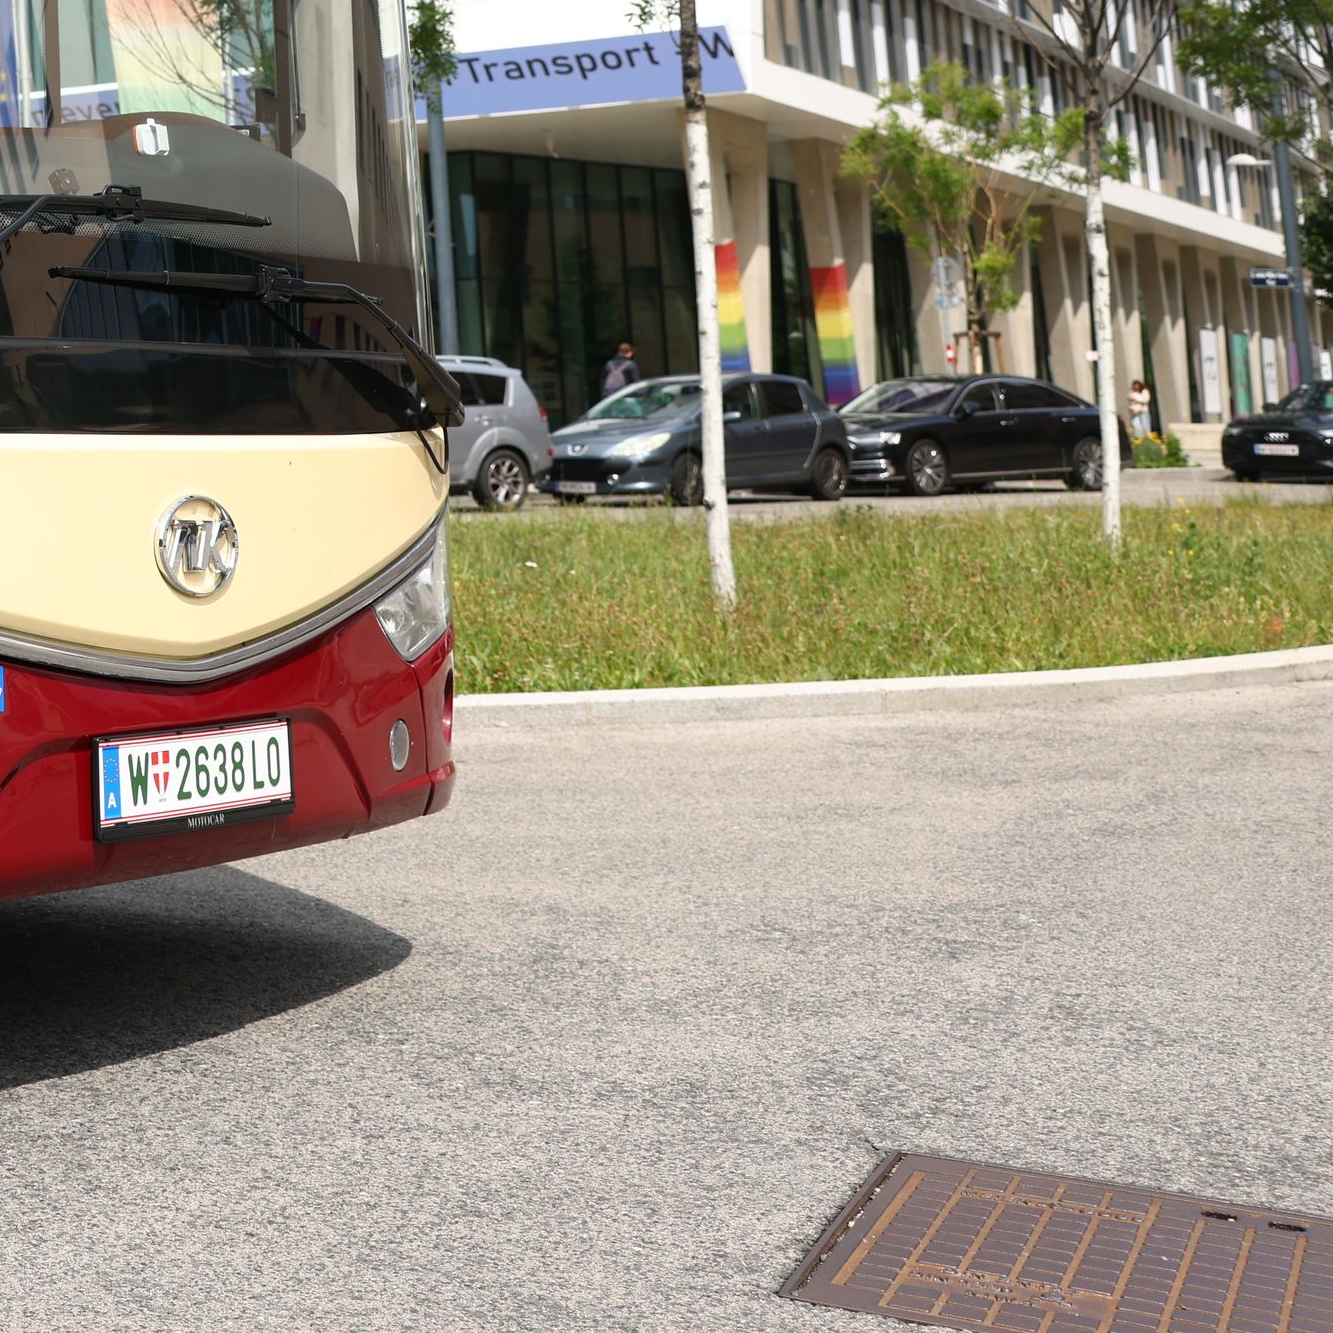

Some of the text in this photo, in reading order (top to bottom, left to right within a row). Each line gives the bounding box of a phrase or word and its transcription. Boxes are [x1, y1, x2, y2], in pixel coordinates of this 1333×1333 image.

[457, 39, 661, 84] Transport
[107, 792, 117, 809] A
[187, 813, 225, 829] MOTOCAR
